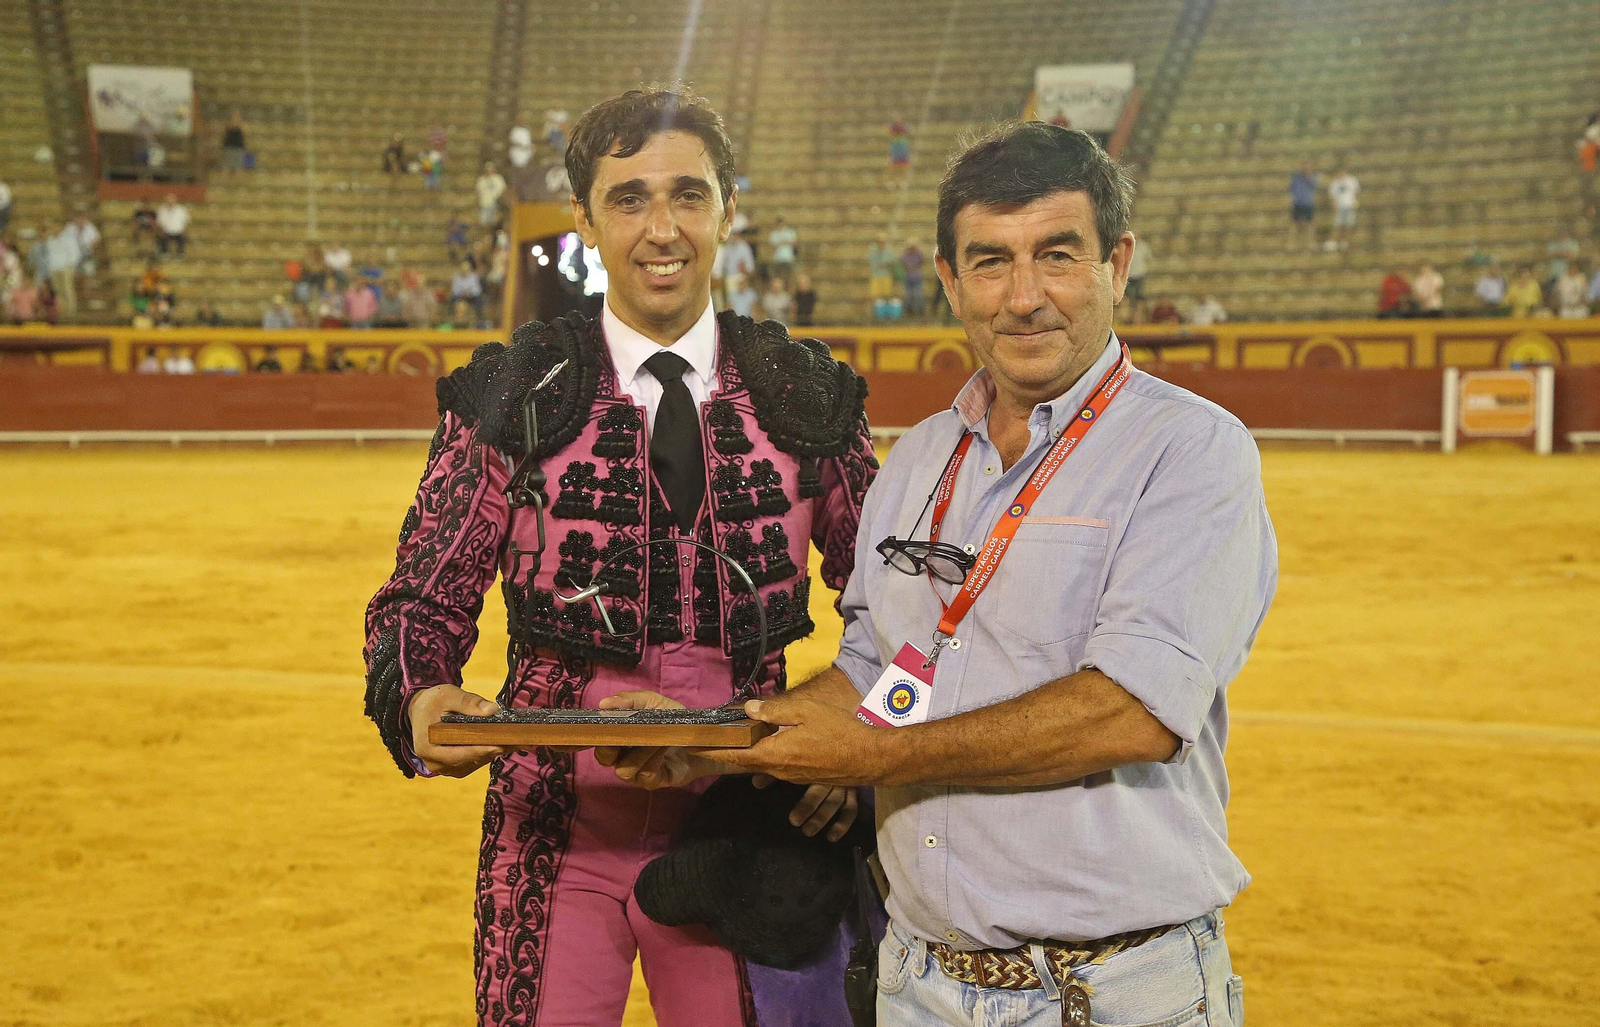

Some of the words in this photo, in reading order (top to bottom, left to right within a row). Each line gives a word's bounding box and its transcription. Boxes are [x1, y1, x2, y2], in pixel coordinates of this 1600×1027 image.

[1104, 375, 1125, 399] CARMELO
[1032, 437, 1067, 485] ESPECTÁCULOS
[1035, 460, 1060, 491] CARMELO
[965, 537, 998, 591] ESPECTÁCULOS
[970, 564, 994, 599] CARMELO
[893, 679, 920, 703] ESPECTÁCULOS
